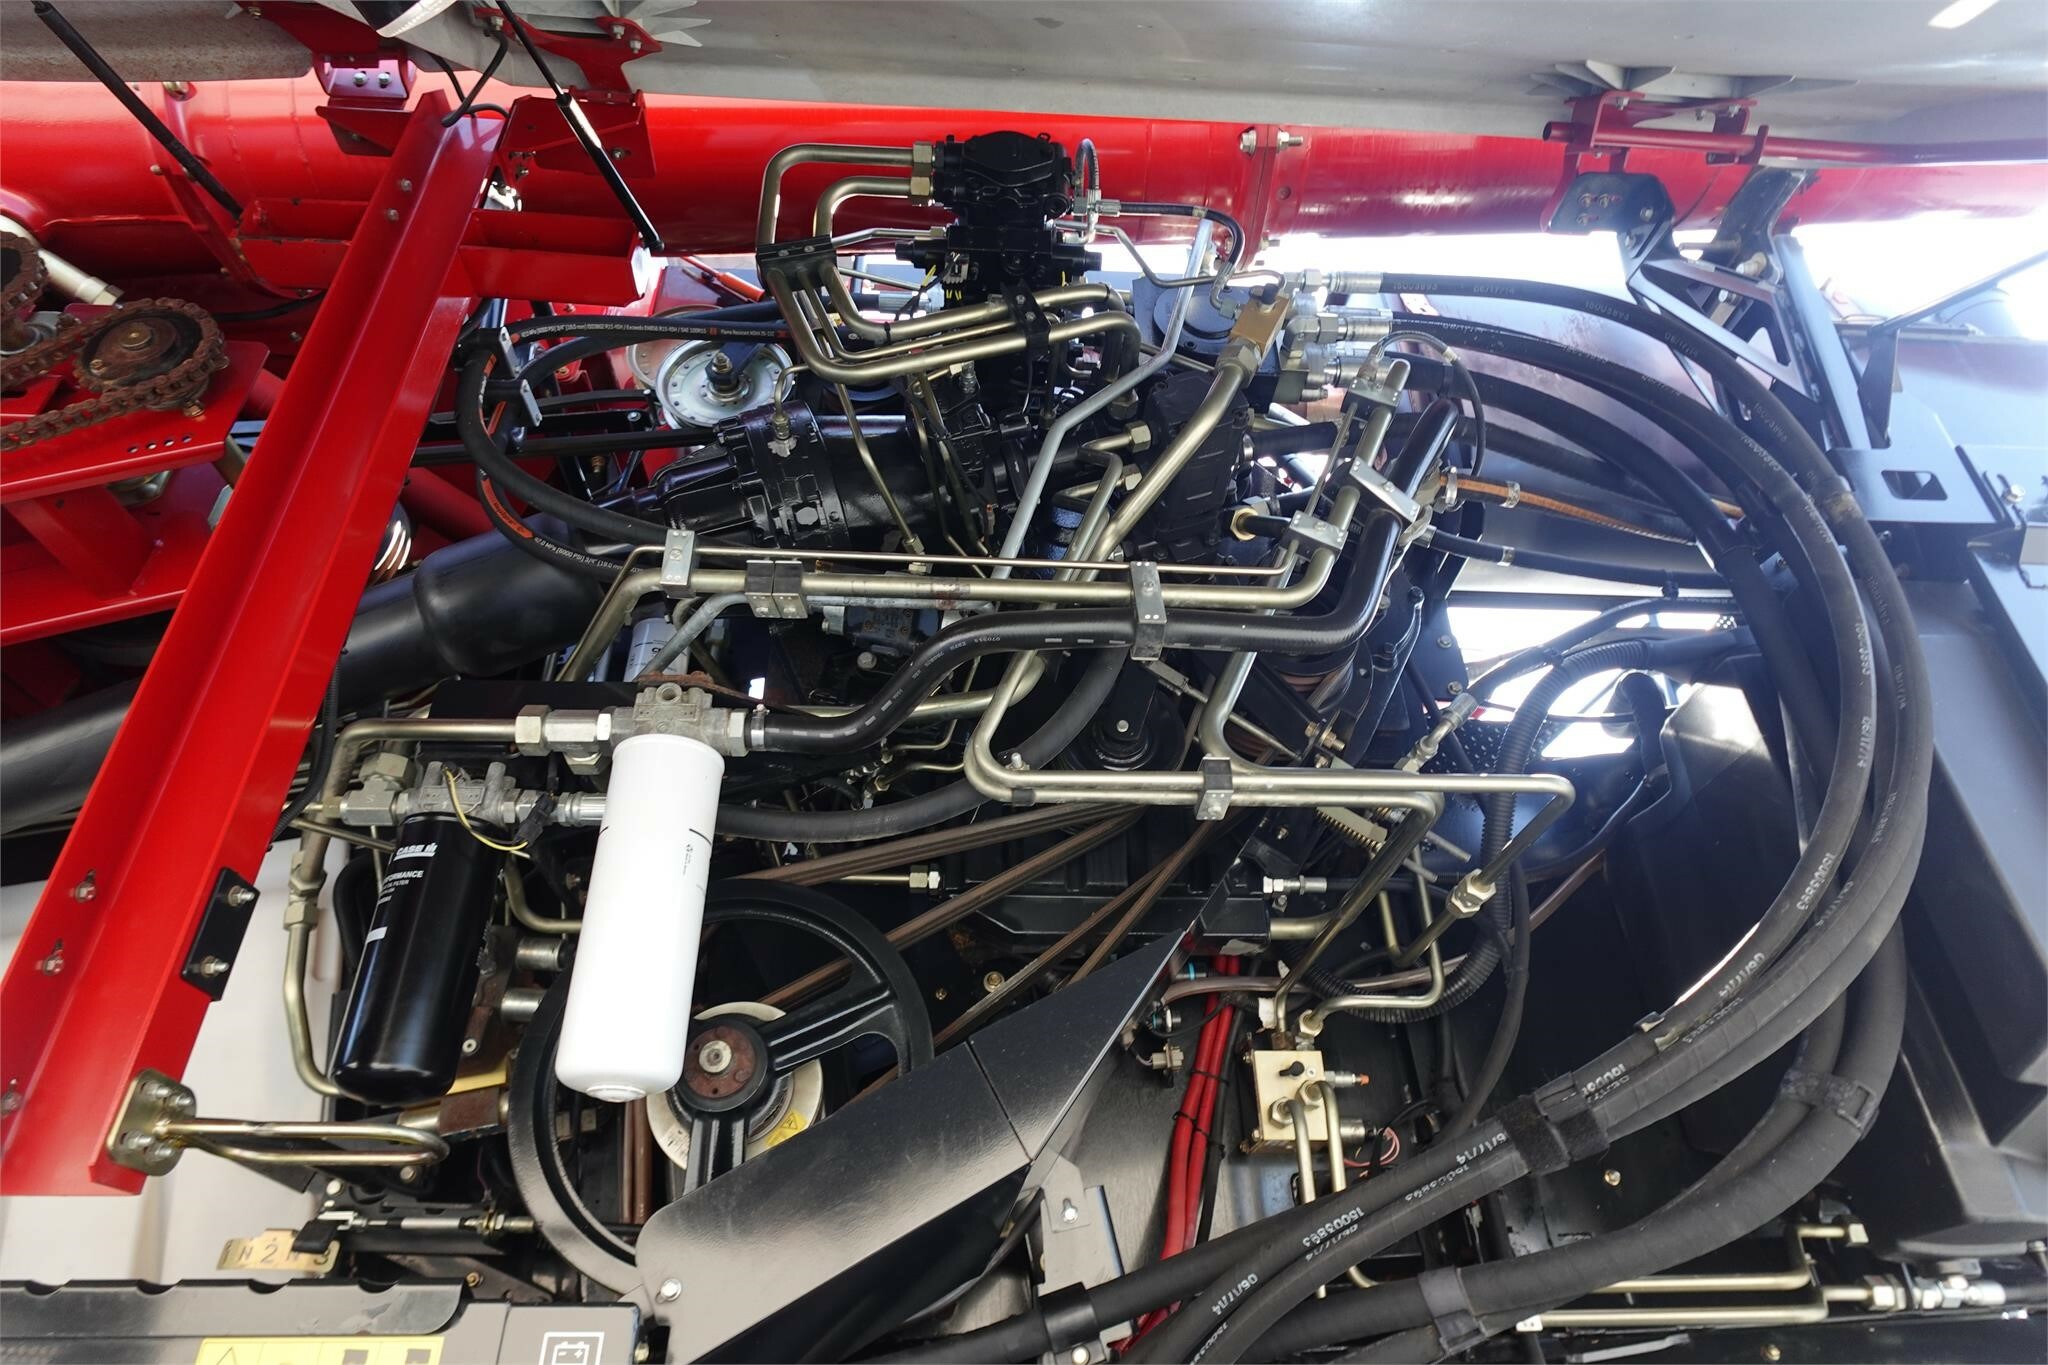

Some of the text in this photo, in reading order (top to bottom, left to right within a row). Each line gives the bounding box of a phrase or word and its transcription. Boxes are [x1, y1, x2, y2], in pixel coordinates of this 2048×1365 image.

[396, 845, 425, 857] CASE
[1302, 1206, 1366, 1248] 15003893
[260, 1243, 278, 1264] 2
